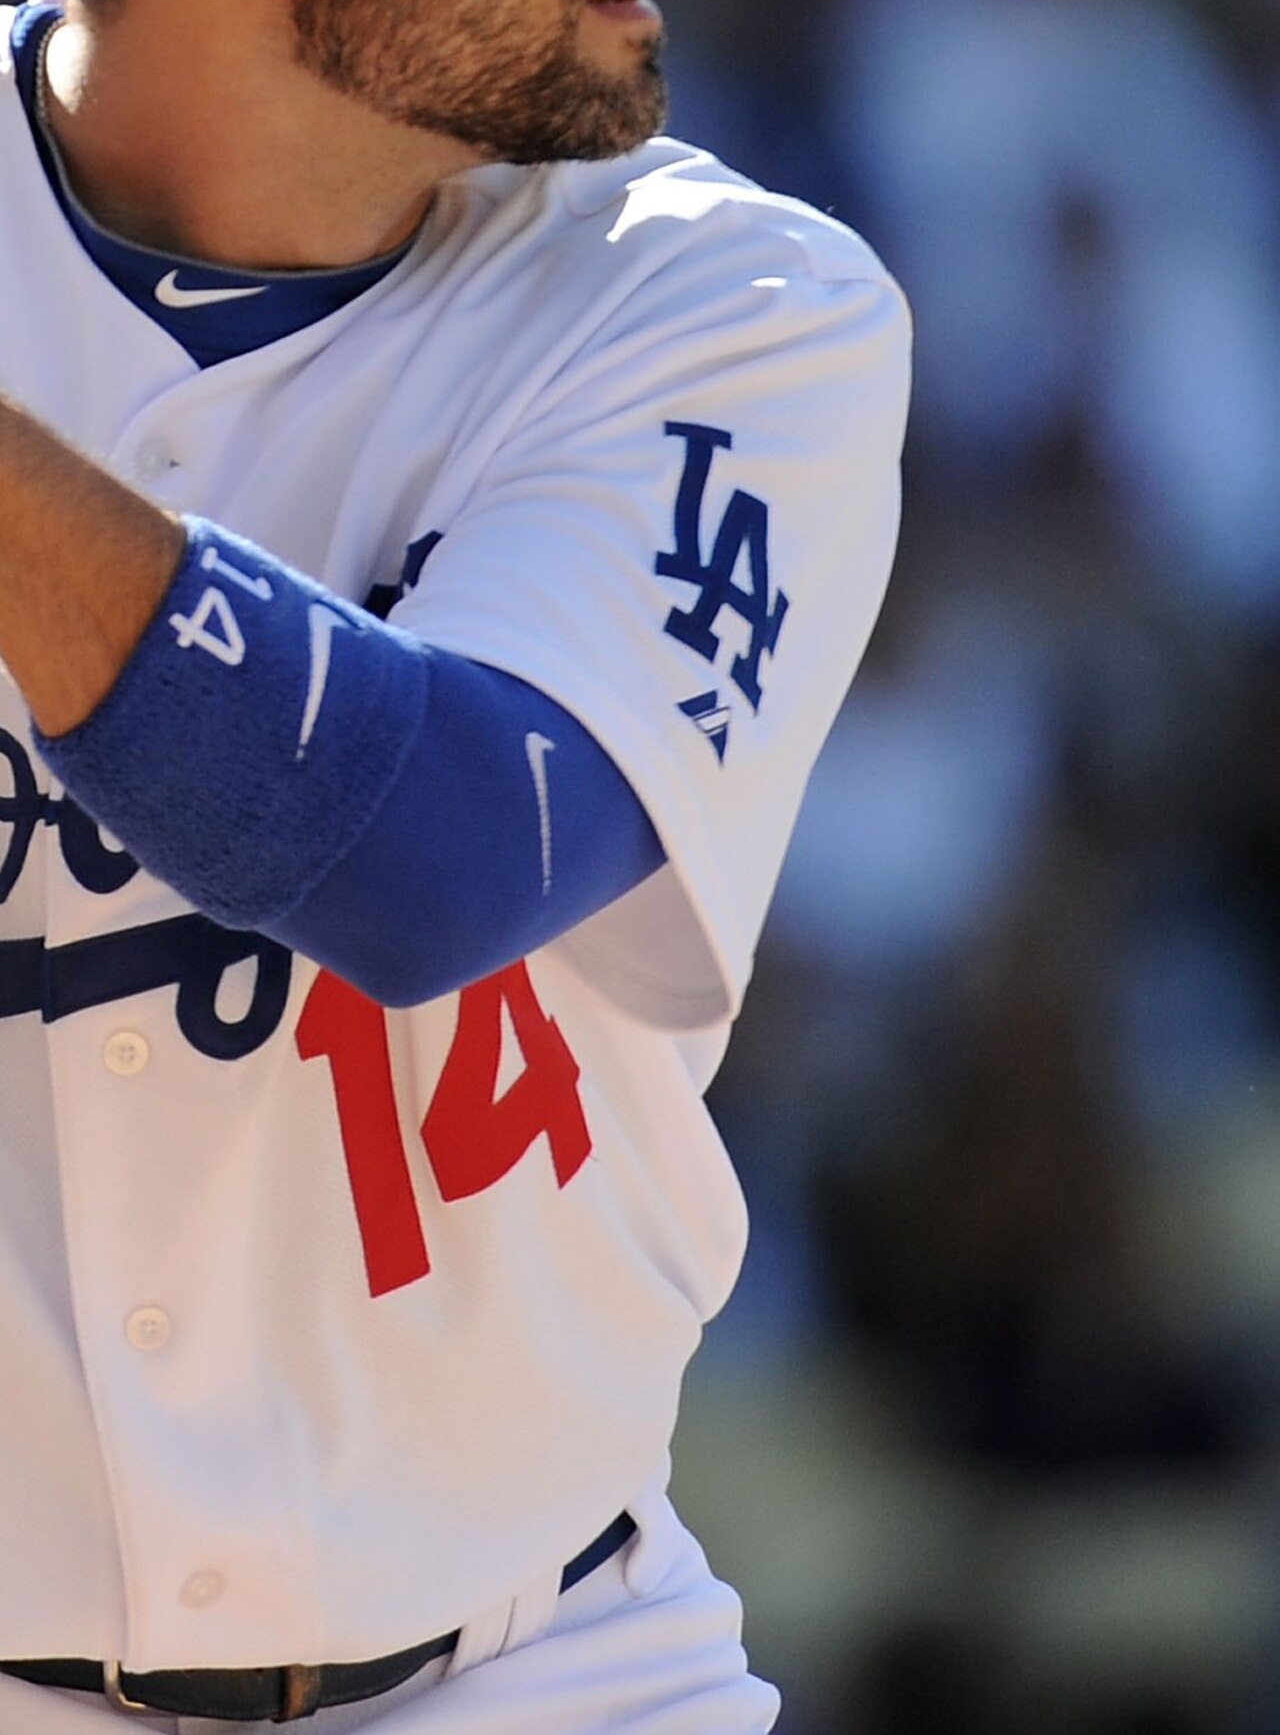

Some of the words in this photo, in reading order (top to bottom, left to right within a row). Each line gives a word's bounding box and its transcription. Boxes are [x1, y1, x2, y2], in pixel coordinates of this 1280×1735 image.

[169, 546, 274, 666] 14
[654, 420, 789, 715] LA
[294, 957, 593, 1299] 14
